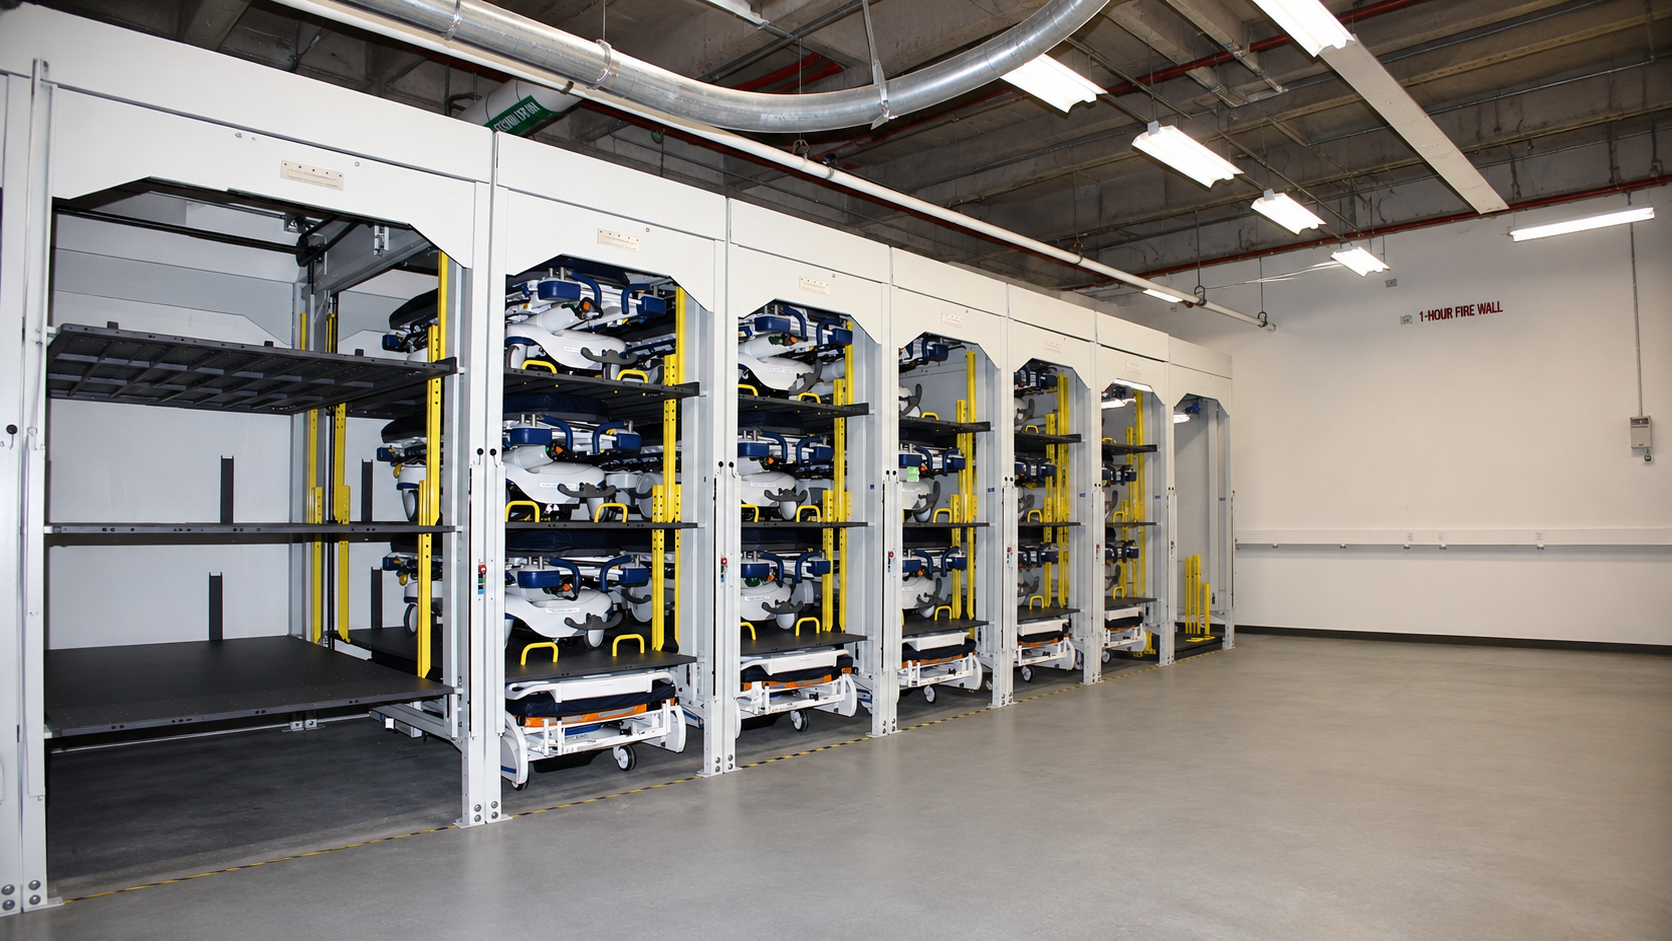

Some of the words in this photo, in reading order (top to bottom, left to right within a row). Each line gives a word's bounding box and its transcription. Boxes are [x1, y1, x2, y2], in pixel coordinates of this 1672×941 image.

[1419, 307, 1453, 322] 1-HOUR
[1455, 304, 1475, 318] FIRE
[1477, 301, 1503, 315] WALL
